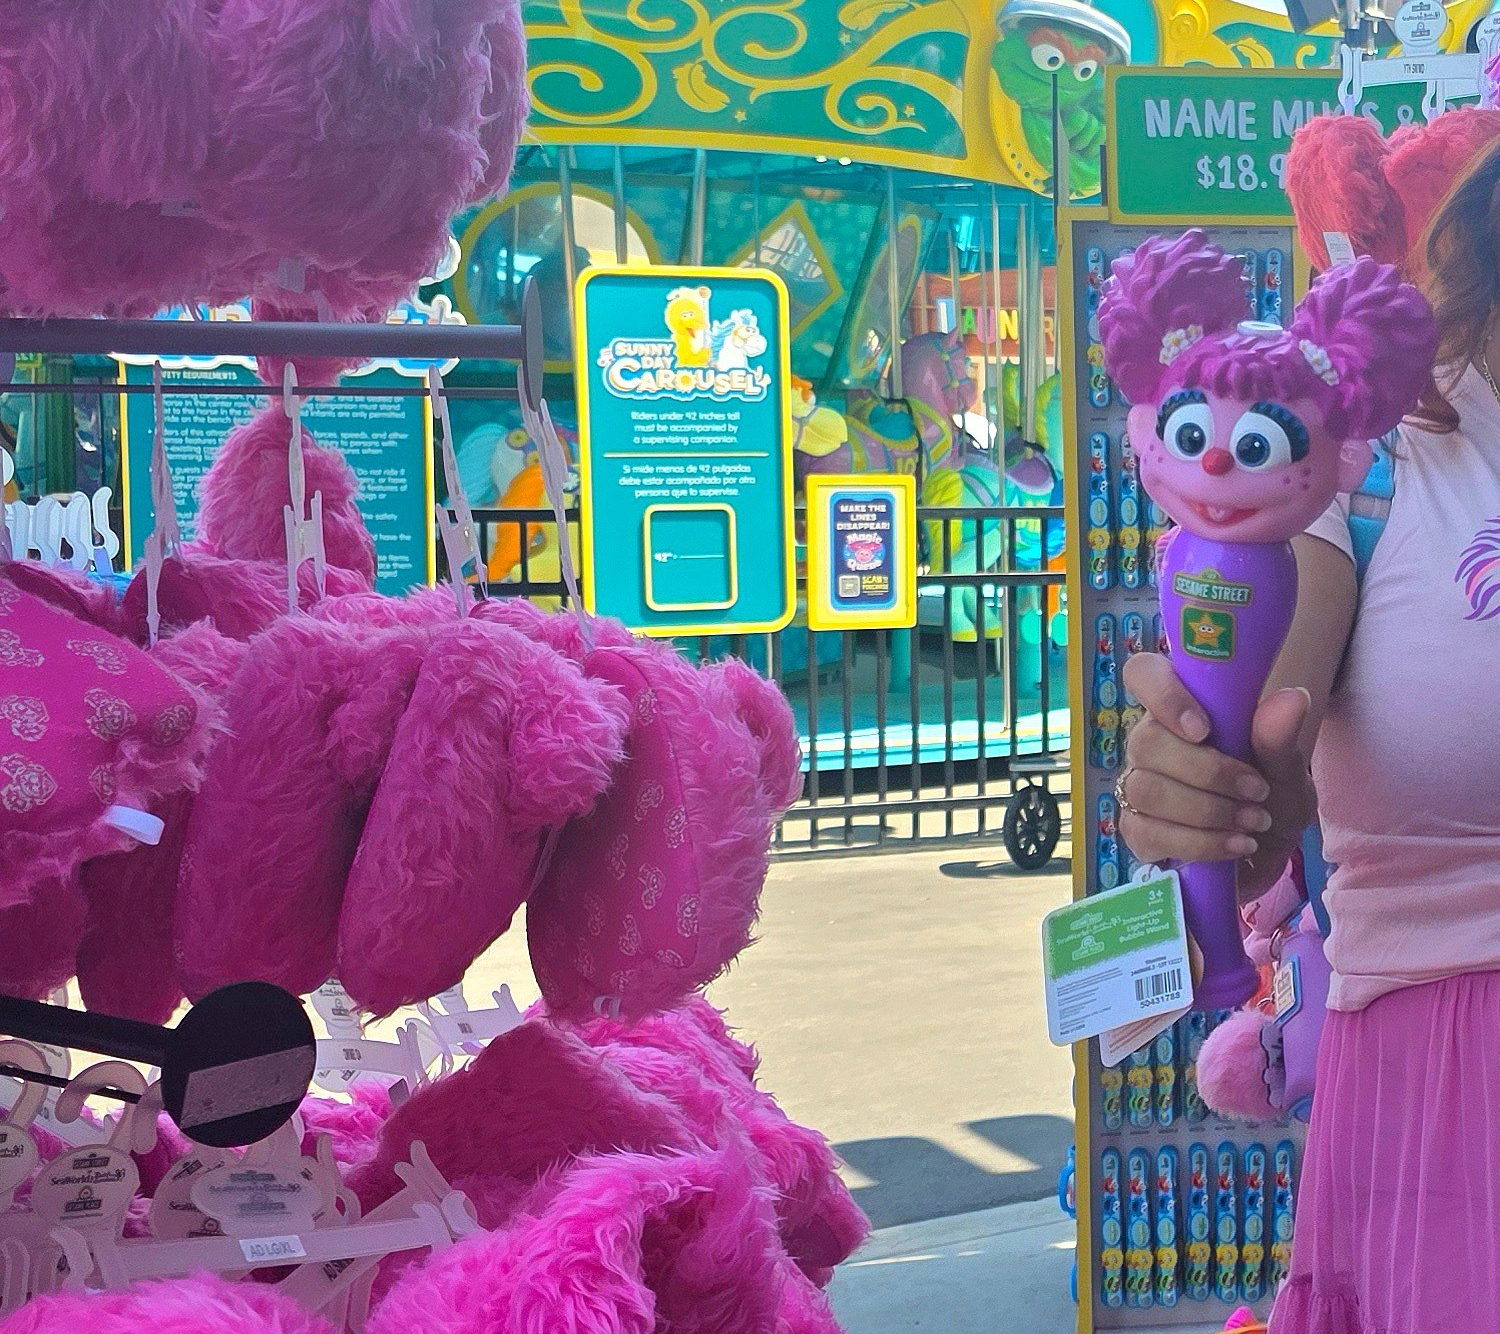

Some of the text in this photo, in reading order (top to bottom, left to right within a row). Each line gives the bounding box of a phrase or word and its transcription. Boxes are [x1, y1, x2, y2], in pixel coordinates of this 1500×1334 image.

[1144, 98, 1258, 141] NAME
[1273, 99, 1386, 138] MS
[1196, 154, 1287, 192] $18.9
[615, 342, 675, 357] SUNNY
[641, 356, 675, 370] DAY
[609, 358, 764, 396] CAROUSEL
[840, 504, 887, 513] MAKE THE
[846, 532, 883, 545] Magic
[1175, 576, 1250, 602] SESAME STREET
[1148, 888, 1164, 901] 3+
[1145, 921, 1170, 935] Wand
[250, 1244, 265, 1257] AD
